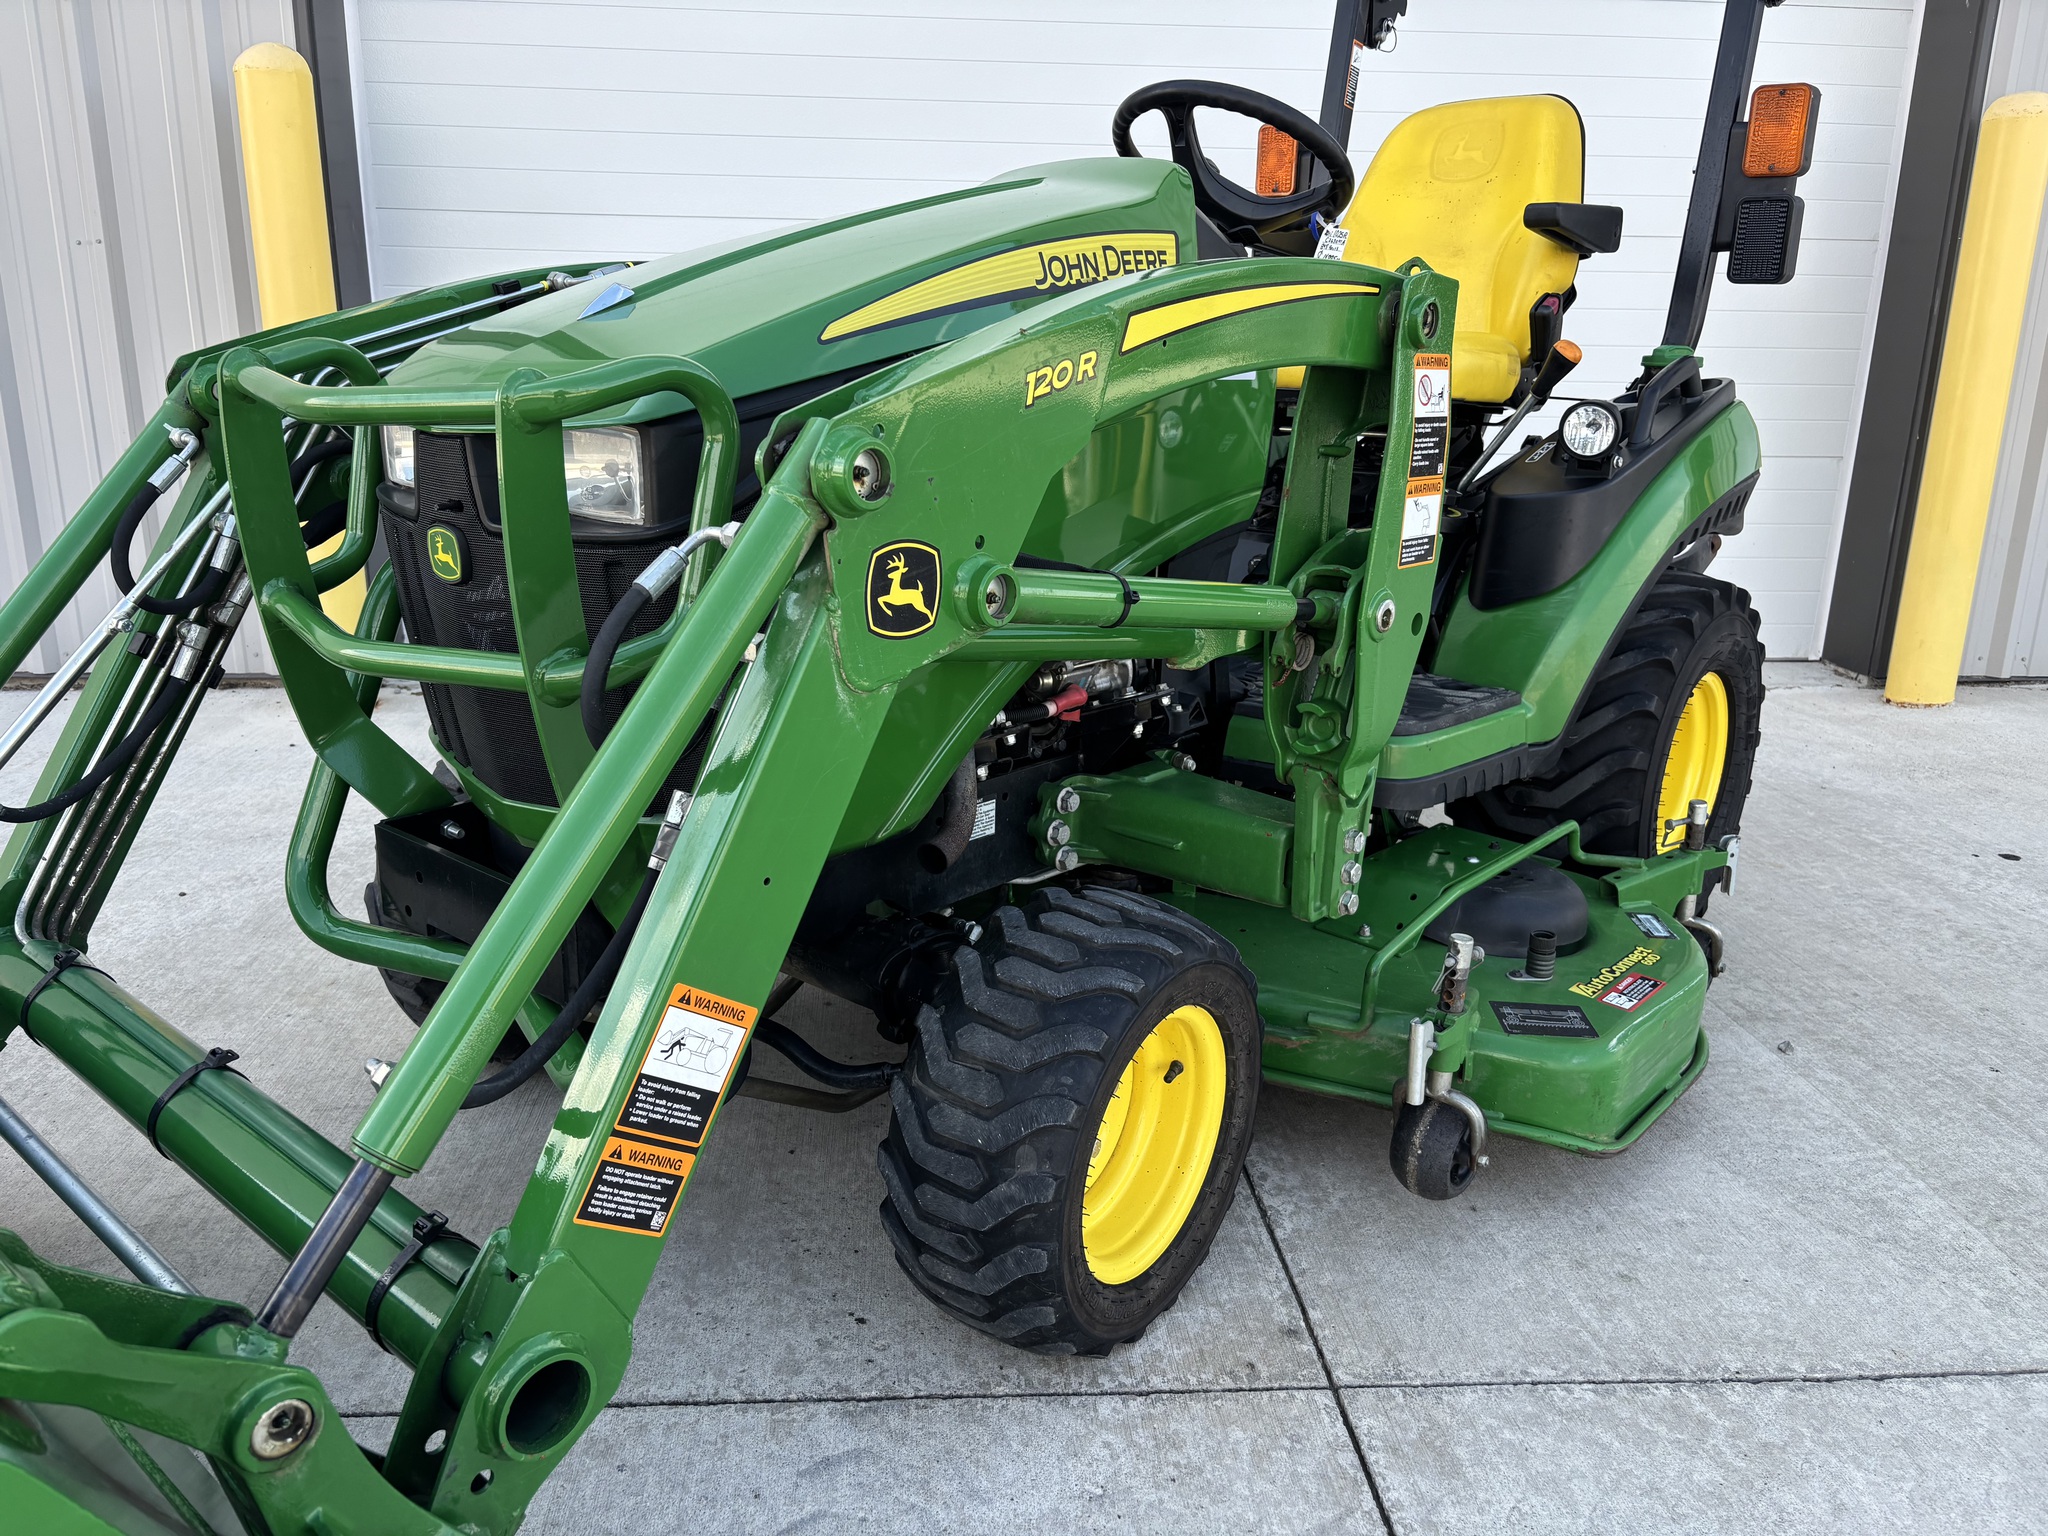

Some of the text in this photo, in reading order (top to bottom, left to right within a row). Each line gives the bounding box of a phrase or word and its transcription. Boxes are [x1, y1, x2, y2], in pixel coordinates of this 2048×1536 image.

[1034, 251, 1101, 286] JOHN
[1421, 356, 1448, 368] WARNING
[1414, 482, 1441, 494] WARNING
[1578, 946, 1653, 996] AutoConnect
[694, 995, 746, 1022] WARNING
[661, 1084, 675, 1093] injury
[686, 1091, 700, 1099] falling
[628, 1148, 683, 1171] WARNING
[602, 1175, 624, 1184] engaging
[624, 1179, 649, 1187] attachment
[588, 1206, 602, 1214] bodily
[613, 1196, 639, 1205] attachment
[639, 1201, 660, 1210] detaching
